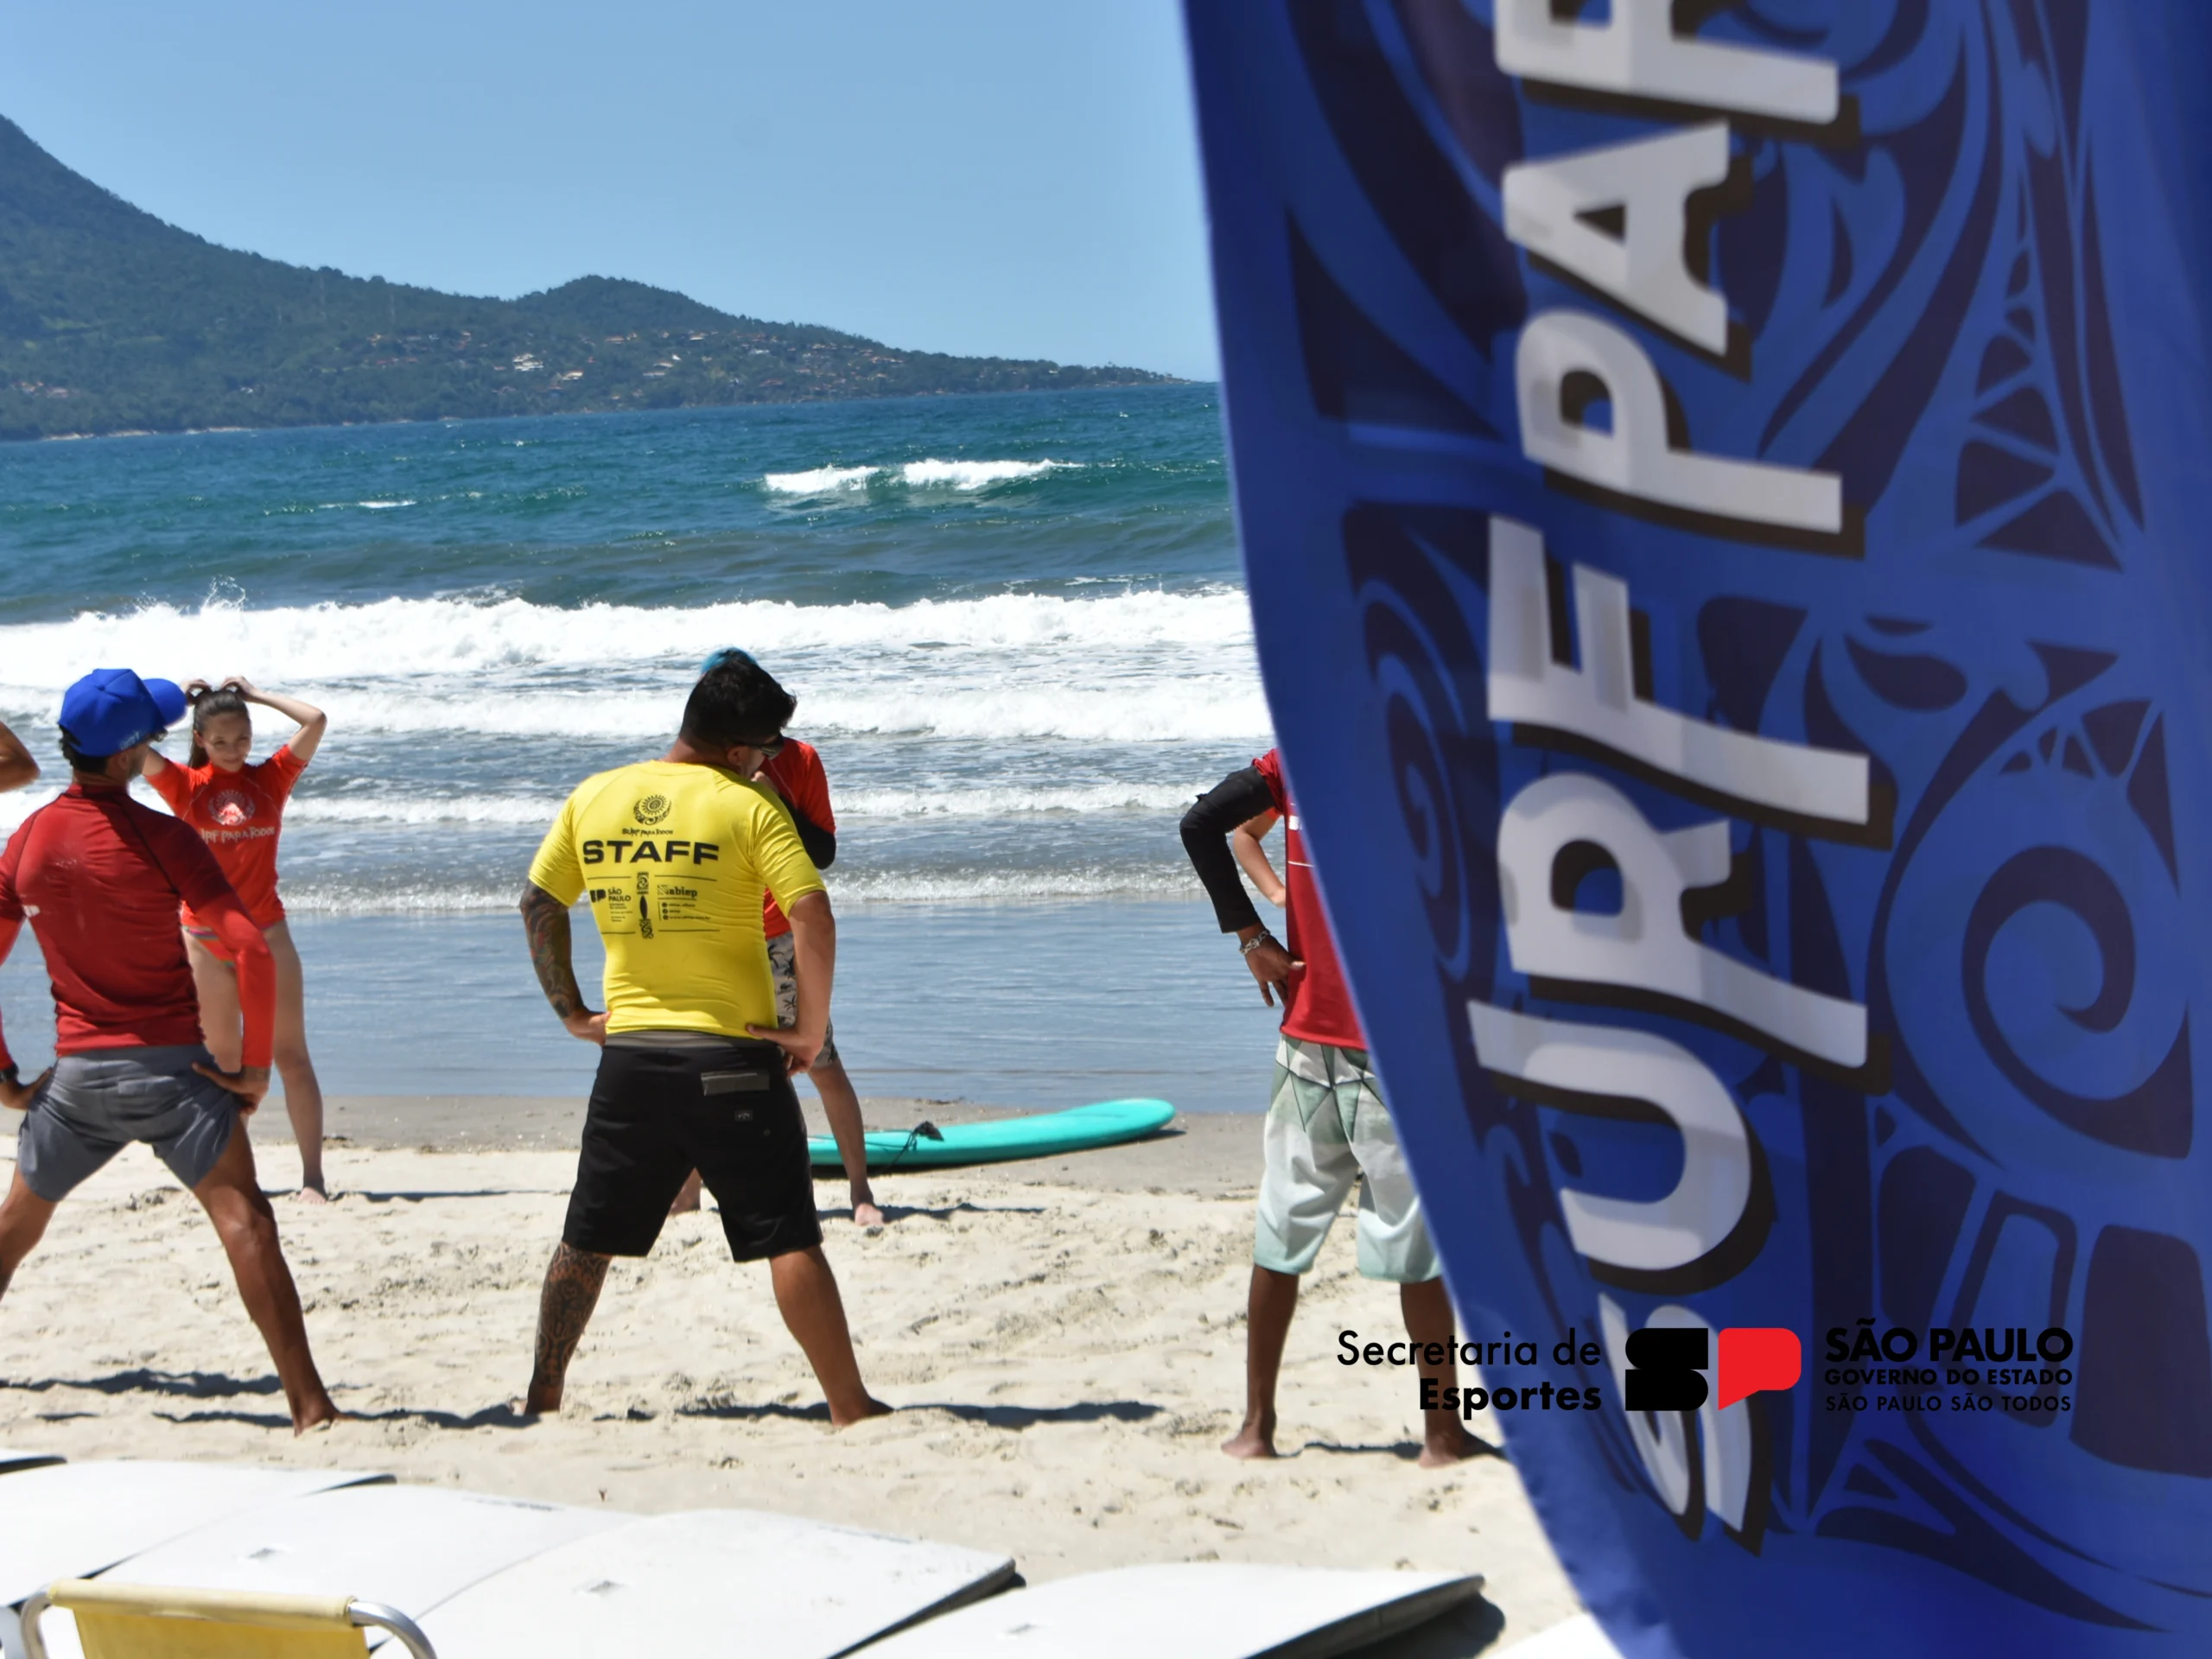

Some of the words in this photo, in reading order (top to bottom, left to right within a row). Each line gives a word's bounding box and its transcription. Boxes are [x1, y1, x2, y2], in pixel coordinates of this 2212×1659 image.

[582, 839, 719, 865] STAFF
[607, 887, 623, 895] SÃO
[1468, 512, 1872, 1533] SURF
